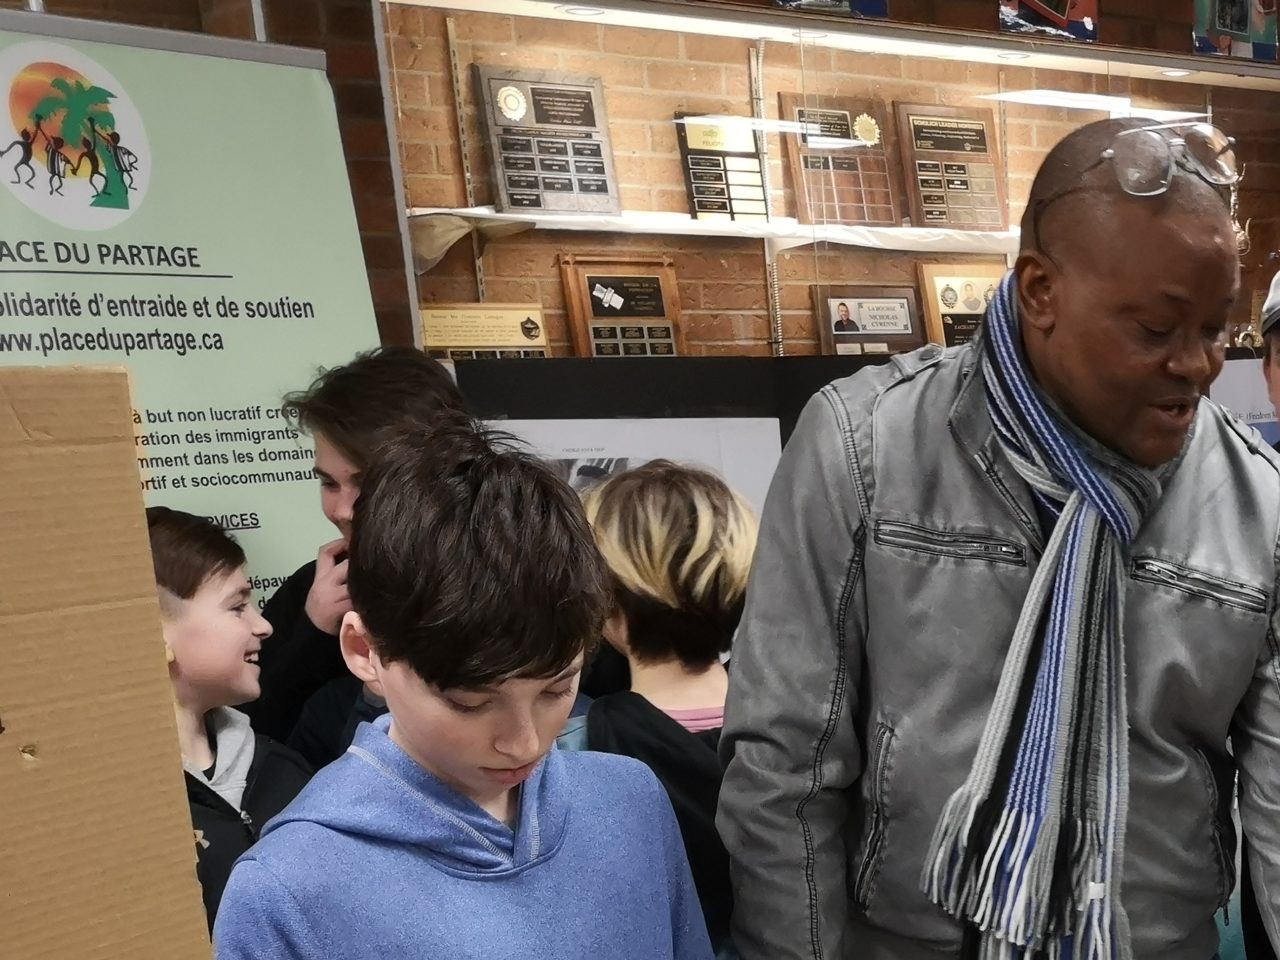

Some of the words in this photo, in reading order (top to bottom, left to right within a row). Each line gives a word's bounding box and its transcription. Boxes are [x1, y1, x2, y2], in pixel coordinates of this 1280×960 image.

[0, 241, 48, 263] ACE
[54, 242, 90, 264] DU
[97, 244, 201, 268] PARTAGE
[0, 292, 82, 317] lidarité
[87, 293, 188, 318] d'entraide
[193, 296, 212, 318] et
[216, 296, 240, 318] de
[245, 296, 315, 319] soutien
[0, 327, 224, 357] ww.placedupartage.ca
[133, 410, 142, 424] à
[146, 409, 173, 424] but
[178, 410, 206, 423] non
[210, 406, 262, 422] lucratif
[134, 431, 181, 446] ration
[185, 430, 212, 444] des
[215, 427, 299, 444] immigrants
[138, 453, 190, 468] mment
[194, 451, 229, 466] dans
[233, 449, 254, 463] les
[258, 447, 316, 462] domain
[140, 475, 167, 491] rtif
[172, 475, 187, 489] et
[191, 469, 319, 488] sociocommunaut
